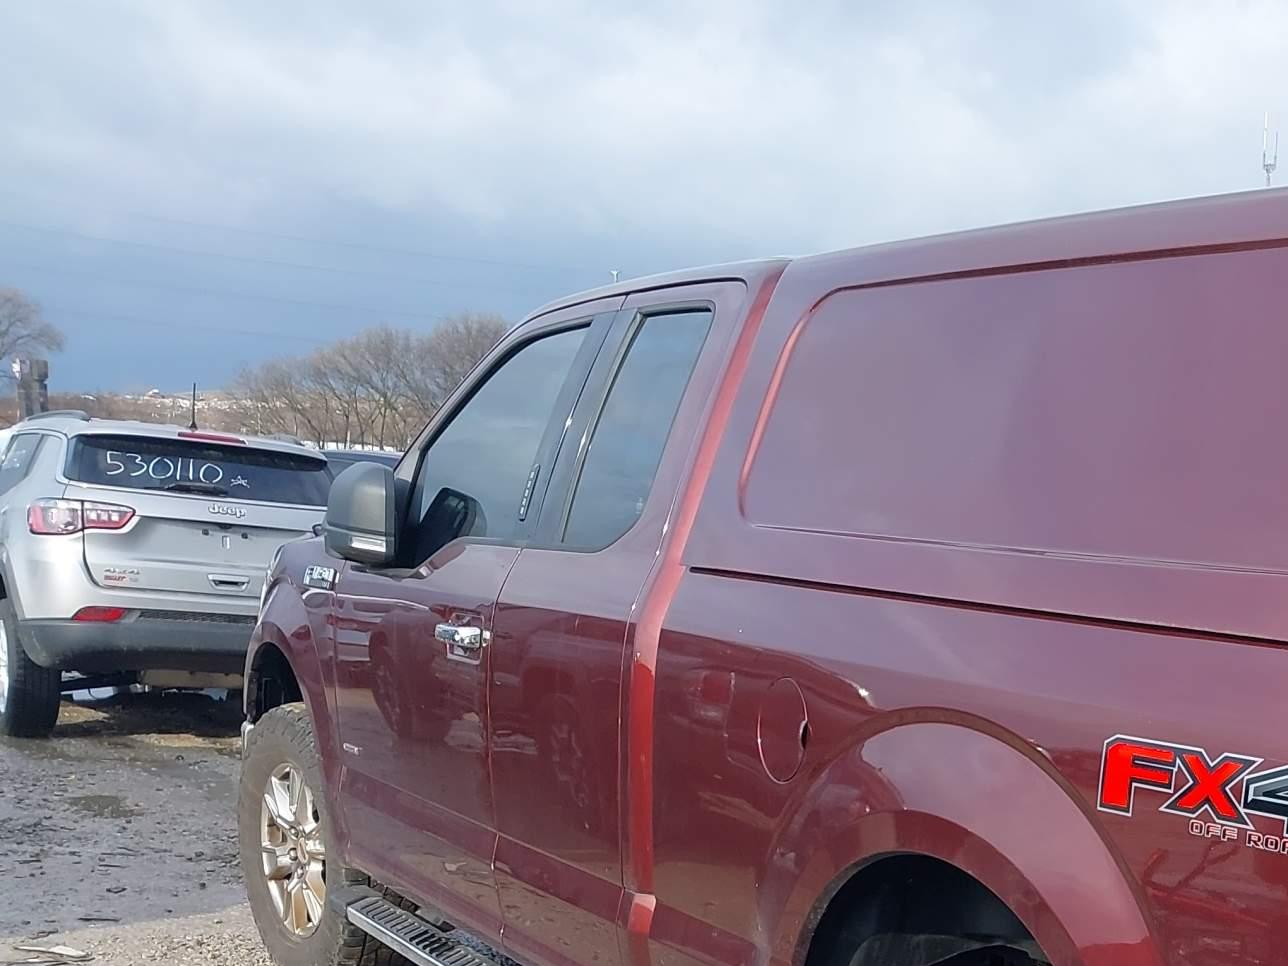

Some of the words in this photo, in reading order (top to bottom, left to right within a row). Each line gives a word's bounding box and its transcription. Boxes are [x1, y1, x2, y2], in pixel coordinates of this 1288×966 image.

[106, 450, 223, 484] 530110
[208, 503, 248, 518] Jeep
[1188, 819, 1238, 841] OFF
